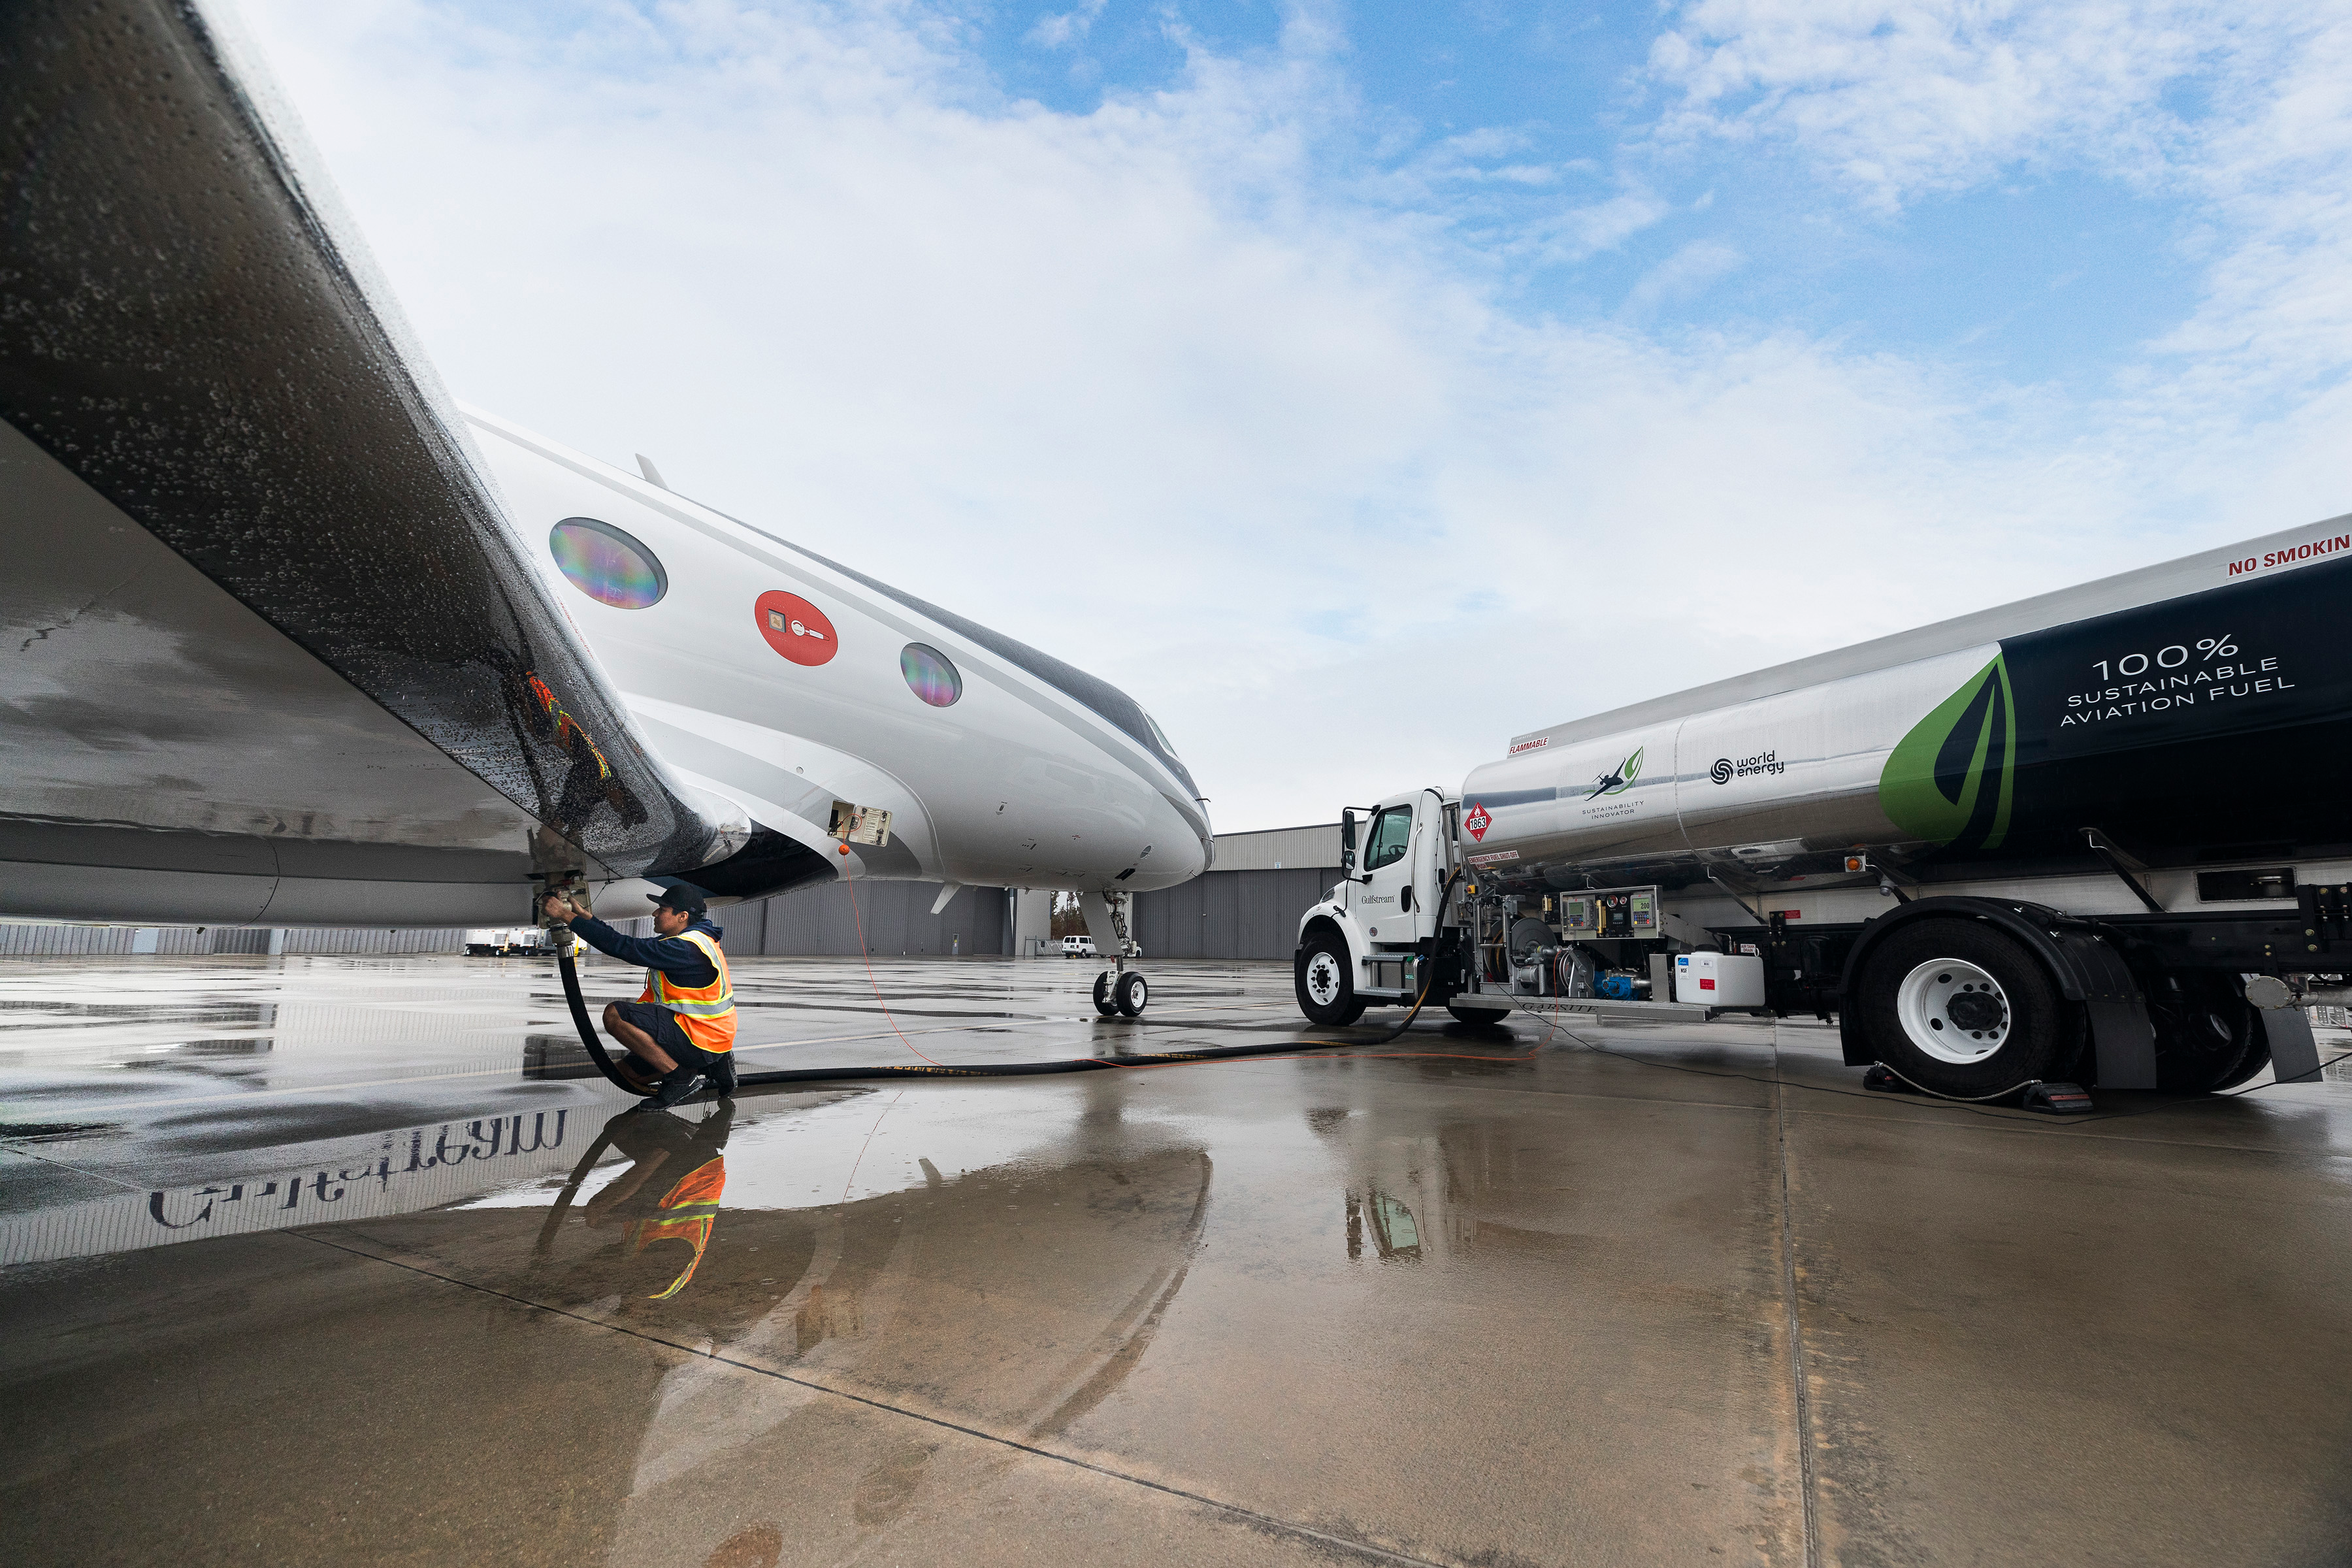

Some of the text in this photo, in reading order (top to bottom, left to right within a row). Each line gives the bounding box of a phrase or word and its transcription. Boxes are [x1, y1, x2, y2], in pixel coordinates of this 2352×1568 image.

[2229, 534, 2352, 576] NO SMOKIN
[2093, 634, 2238, 681] 100%
[2067, 657, 2278, 707] SUSTAINABLE
[2061, 676, 2295, 727] AVIATION FUEL
[1509, 738, 1548, 754] FLAMMABLE
[1737, 749, 1775, 768] world
[1737, 761, 1784, 777] energy
[1582, 800, 1644, 815] SUSTAINABILITY
[1592, 809, 1635, 819] INNOVATOR
[1470, 817, 1486, 830] 1863
[1362, 895, 1394, 904] Gulfstream
[1522, 1002, 1599, 1013] GARSITE
